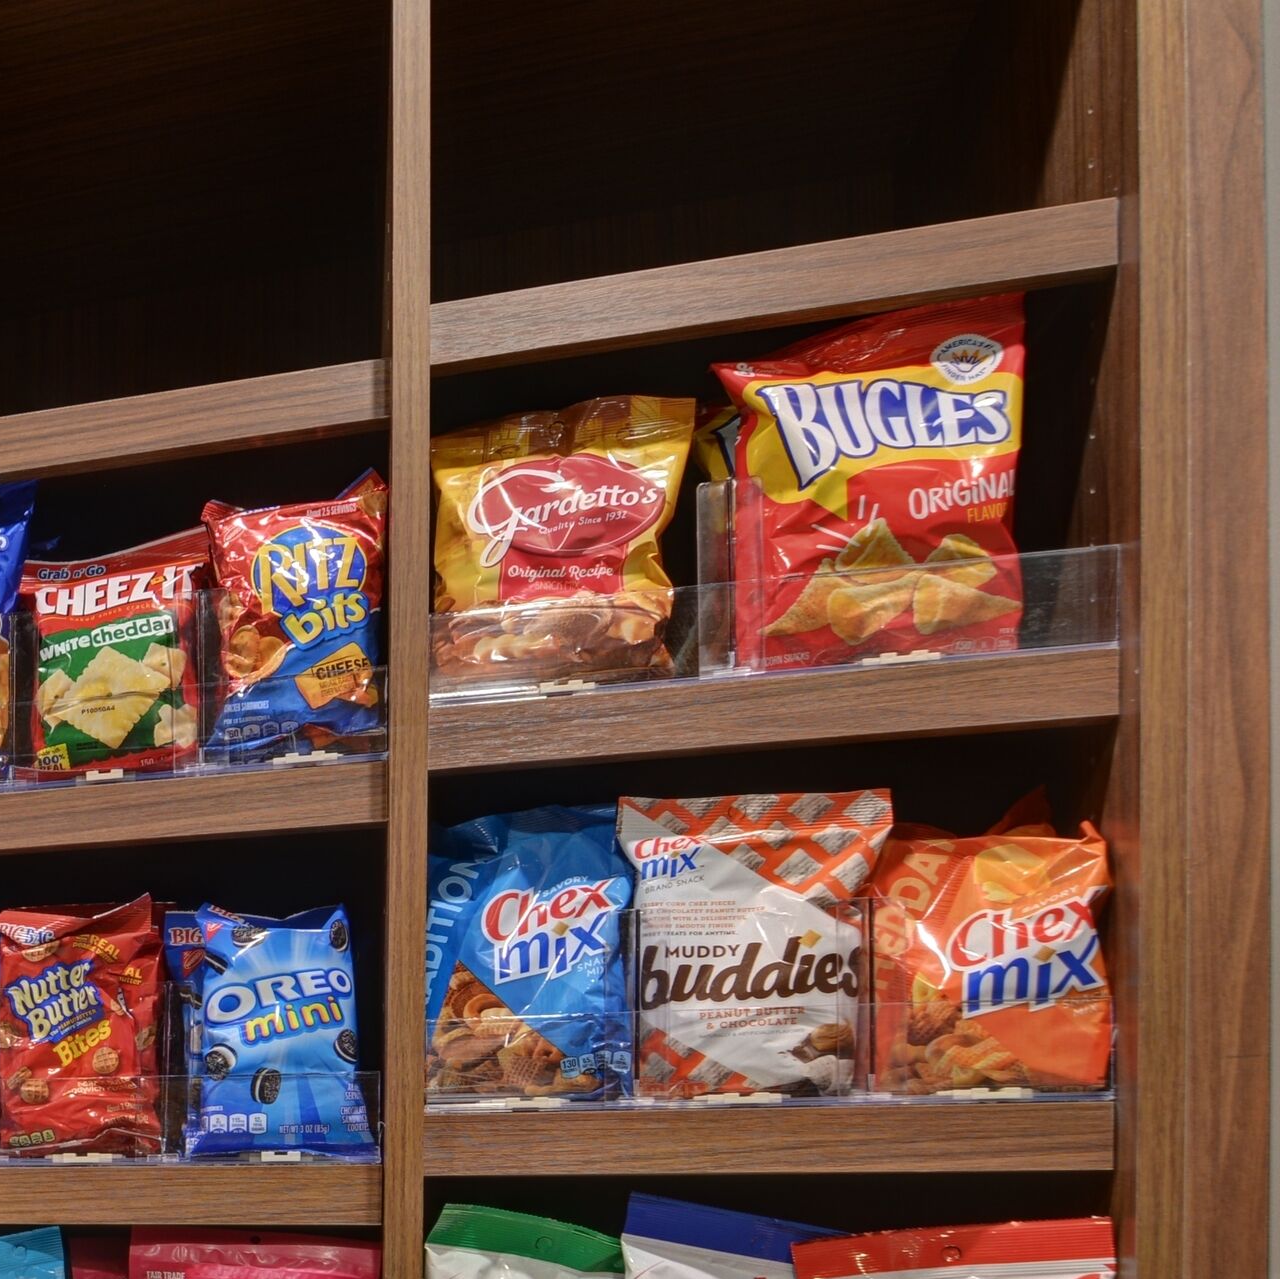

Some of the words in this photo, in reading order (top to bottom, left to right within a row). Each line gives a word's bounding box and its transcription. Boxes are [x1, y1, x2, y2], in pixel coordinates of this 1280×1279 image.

[757, 379, 1010, 489] BUGLES
[539, 519, 575, 535] Quality
[578, 515, 602, 526] Since
[605, 510, 628, 522] 1932
[38, 567, 69, 580] Grab
[85, 565, 106, 576] Go
[258, 536, 358, 616] RITZ
[508, 566, 566, 582] Original
[569, 566, 613, 583] Recipe
[285, 592, 367, 643] bits
[316, 657, 369, 682] CHEESE
[634, 835, 703, 860] Chex
[641, 847, 701, 881] mix
[483, 877, 617, 942] Chex
[498, 912, 608, 980] mix
[665, 944, 741, 958] MUDDY
[8, 961, 91, 1010] Nutter
[206, 969, 352, 1022] OREO
[641, 935, 859, 1011] buddies
[967, 936, 1099, 1013] mix
[52, 1018, 112, 1067] Bites
[245, 997, 343, 1042] mini
